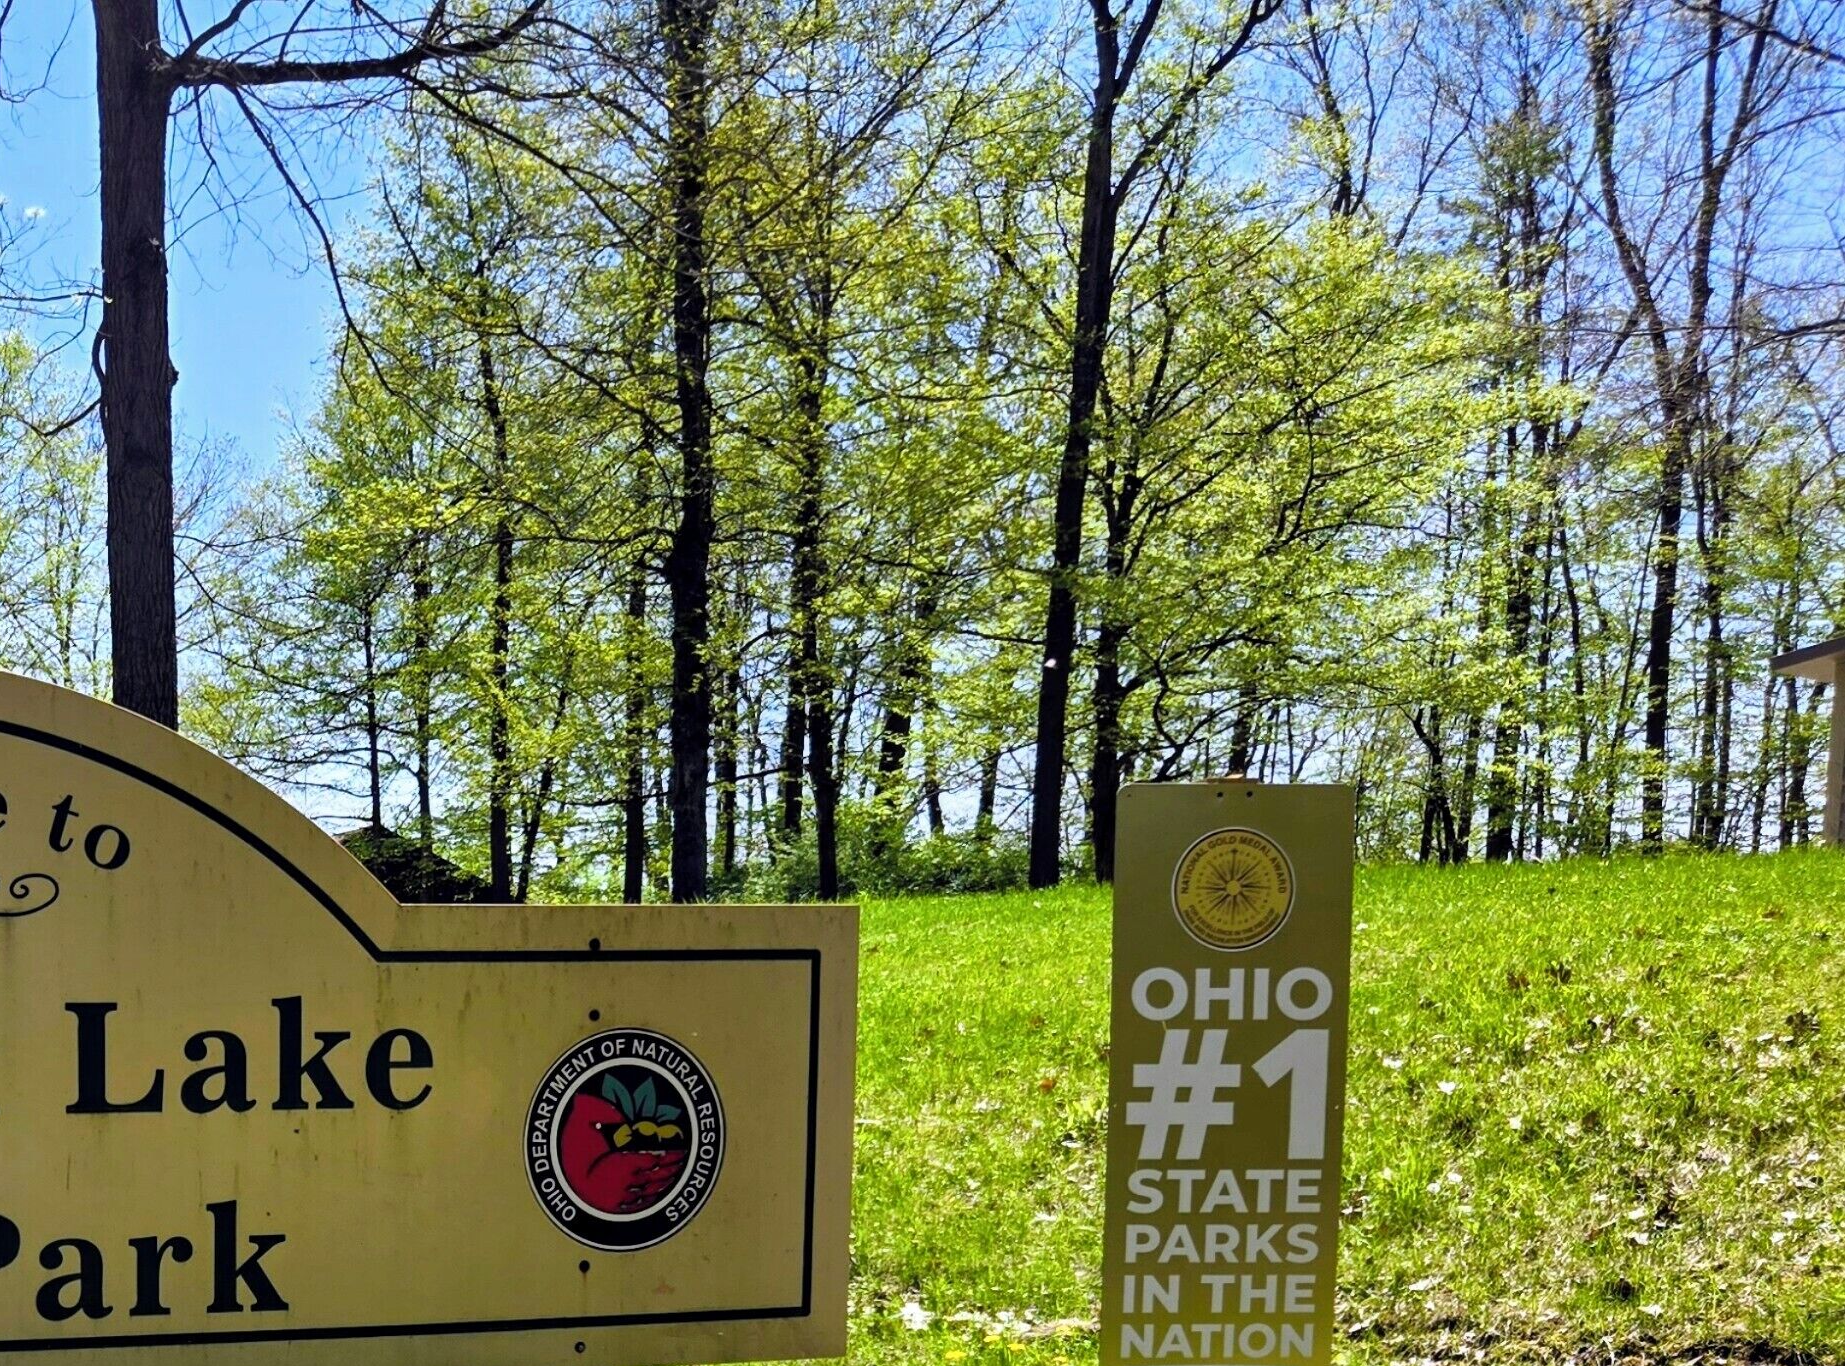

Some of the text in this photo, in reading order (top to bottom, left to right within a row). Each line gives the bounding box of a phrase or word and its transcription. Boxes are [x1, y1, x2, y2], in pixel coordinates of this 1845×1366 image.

[48, 795, 131, 869] to
[1181, 836, 1287, 894] NATIONAL GOLD MEDAL AWARD
[1131, 967, 1332, 1020] OHIO
[64, 995, 434, 1114] Lake
[1125, 1028, 1330, 1160] #1
[532, 1038, 715, 1222] OHIO DEPARTMENT OF NATURAL RESOURCES
[1127, 1169, 1322, 1214] STATE
[1124, 1223, 1319, 1264] PARKS
[1122, 1273, 1315, 1314] IN THE
[1120, 1323, 1314, 1359] NATION
